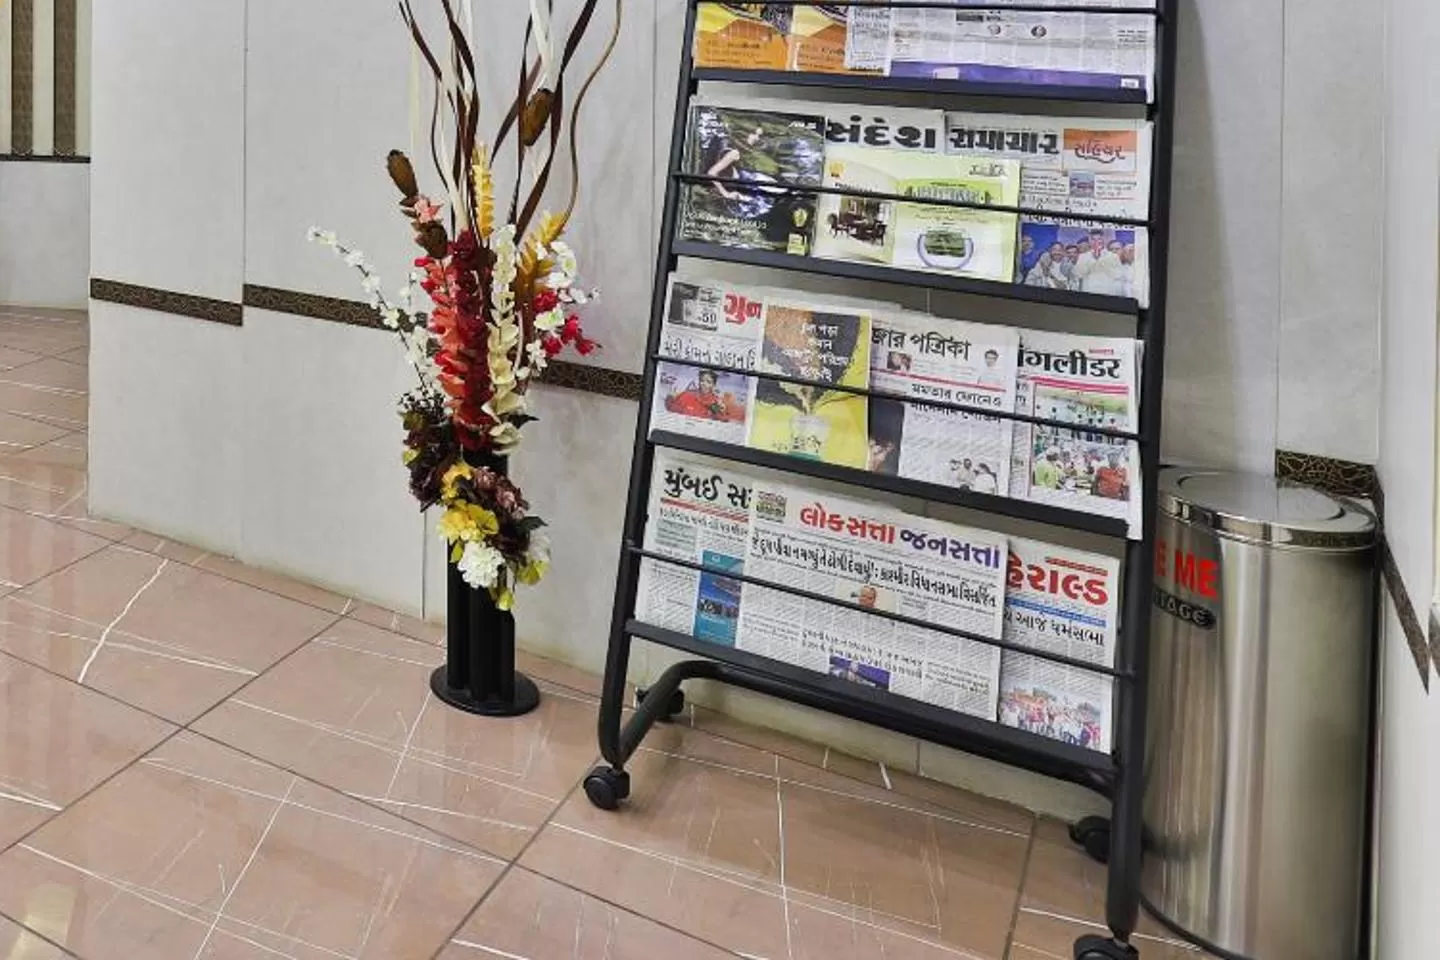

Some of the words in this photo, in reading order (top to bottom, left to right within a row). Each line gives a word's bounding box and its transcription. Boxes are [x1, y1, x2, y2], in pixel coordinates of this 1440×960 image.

[664, 468, 723, 501] મુંબઈ
[800, 502, 895, 545] લોકસત્તા
[900, 528, 1001, 570] જનસત્તા
[1174, 549, 1217, 598] ME
